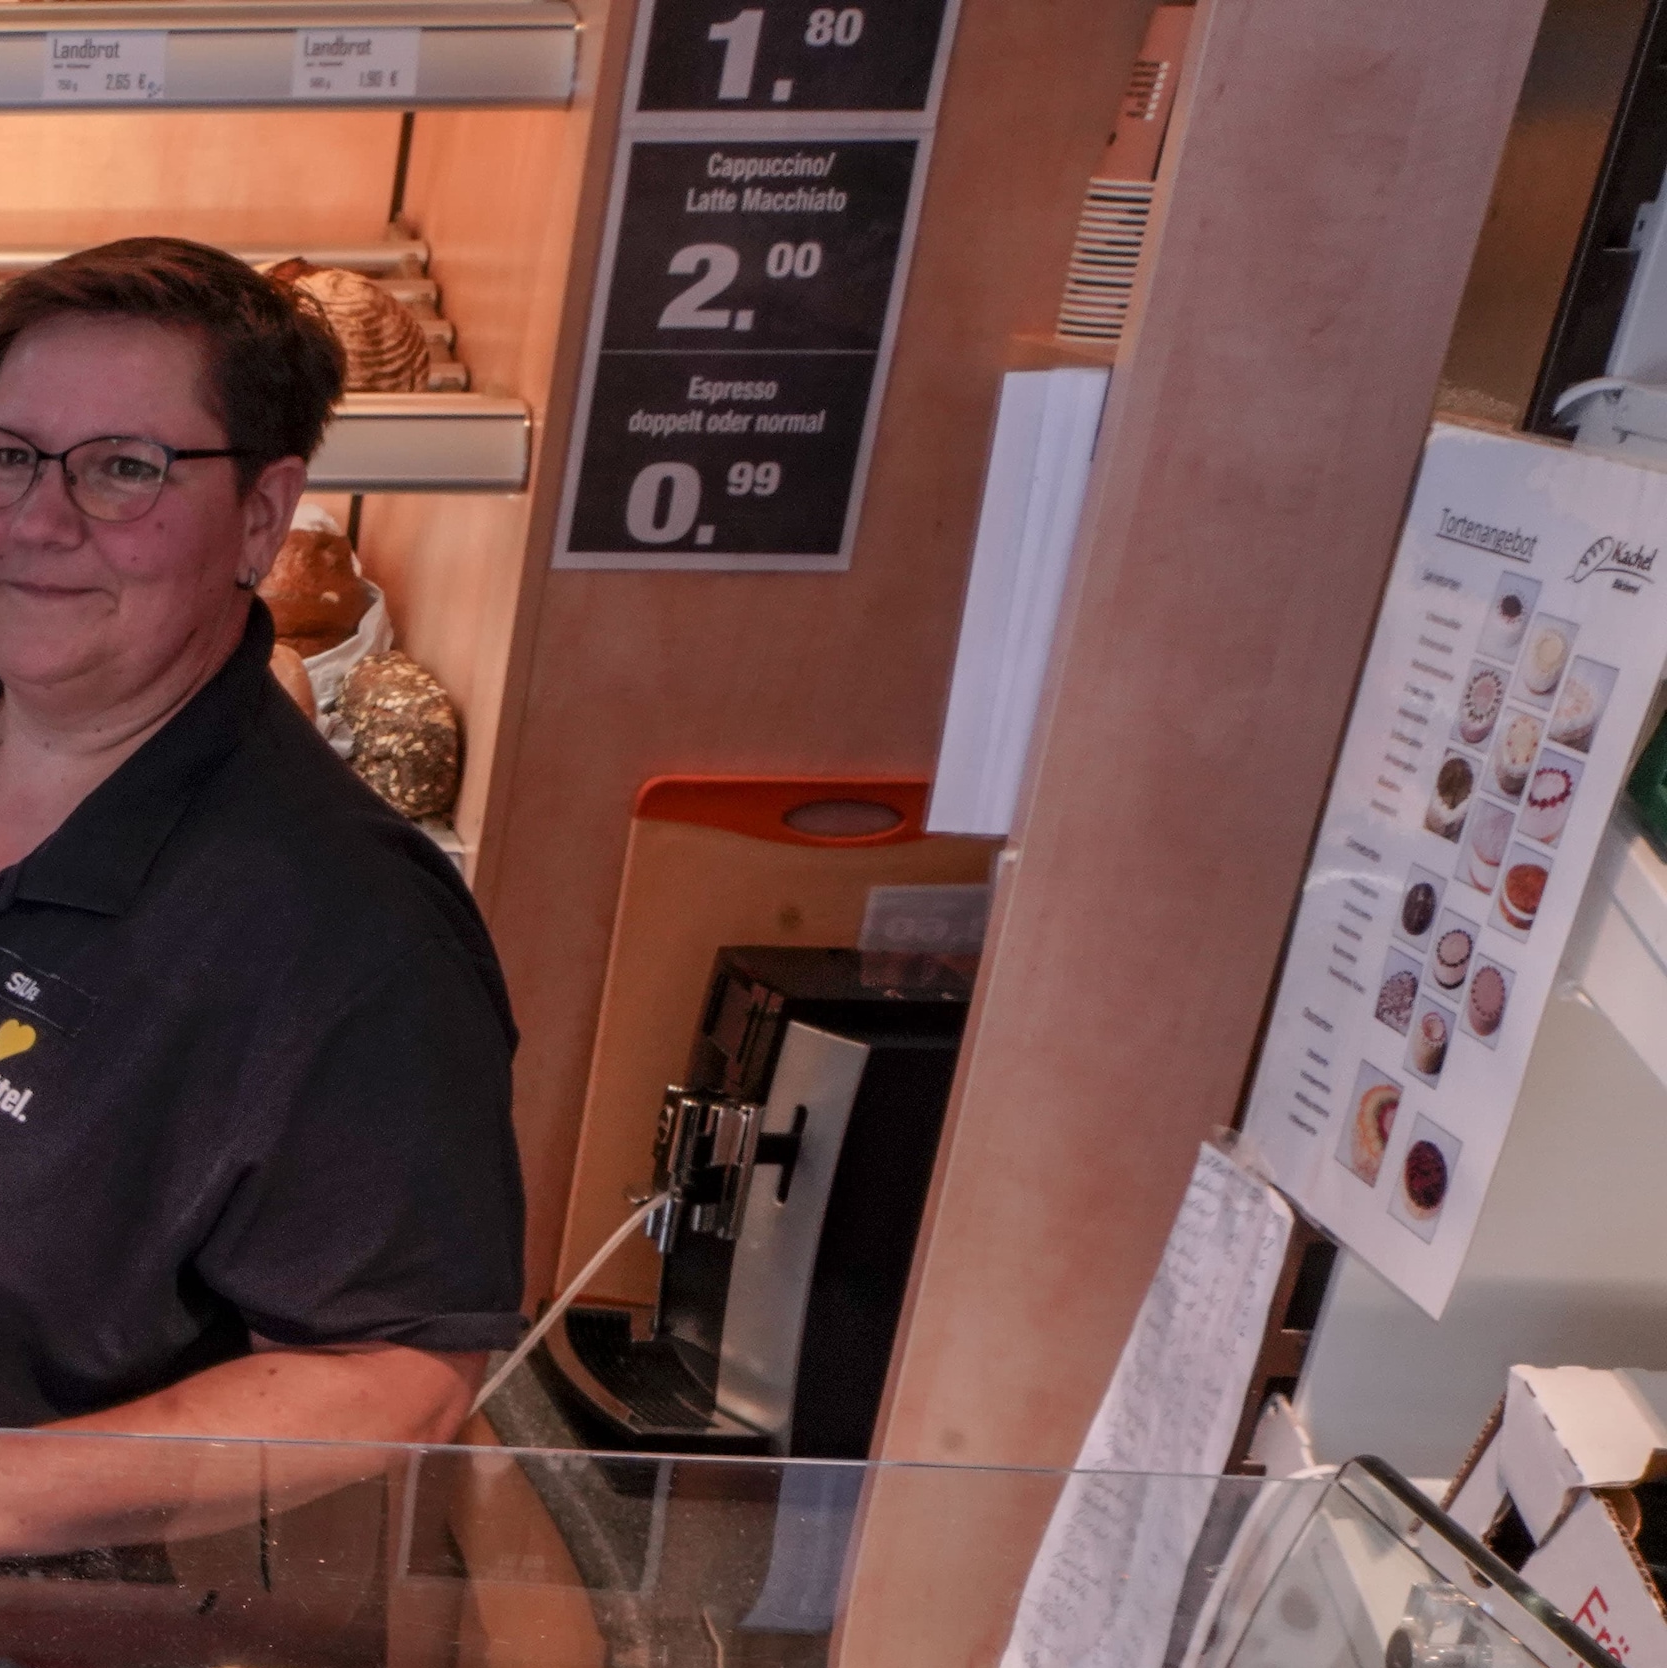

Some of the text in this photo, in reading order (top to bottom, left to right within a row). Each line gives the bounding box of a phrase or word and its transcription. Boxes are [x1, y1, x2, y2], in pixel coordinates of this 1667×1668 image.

[53, 38, 120, 59] Landbrot
[304, 36, 372, 57] Landbrot
[707, 151, 836, 181] Cappuccino/
[685, 186, 849, 213] Latte Macchiato
[686, 374, 779, 404] Espresso
[628, 408, 827, 437] doppelt oder normal
[1439, 507, 1539, 558] Tortenangebot
[1611, 540, 1659, 572] Kachel
